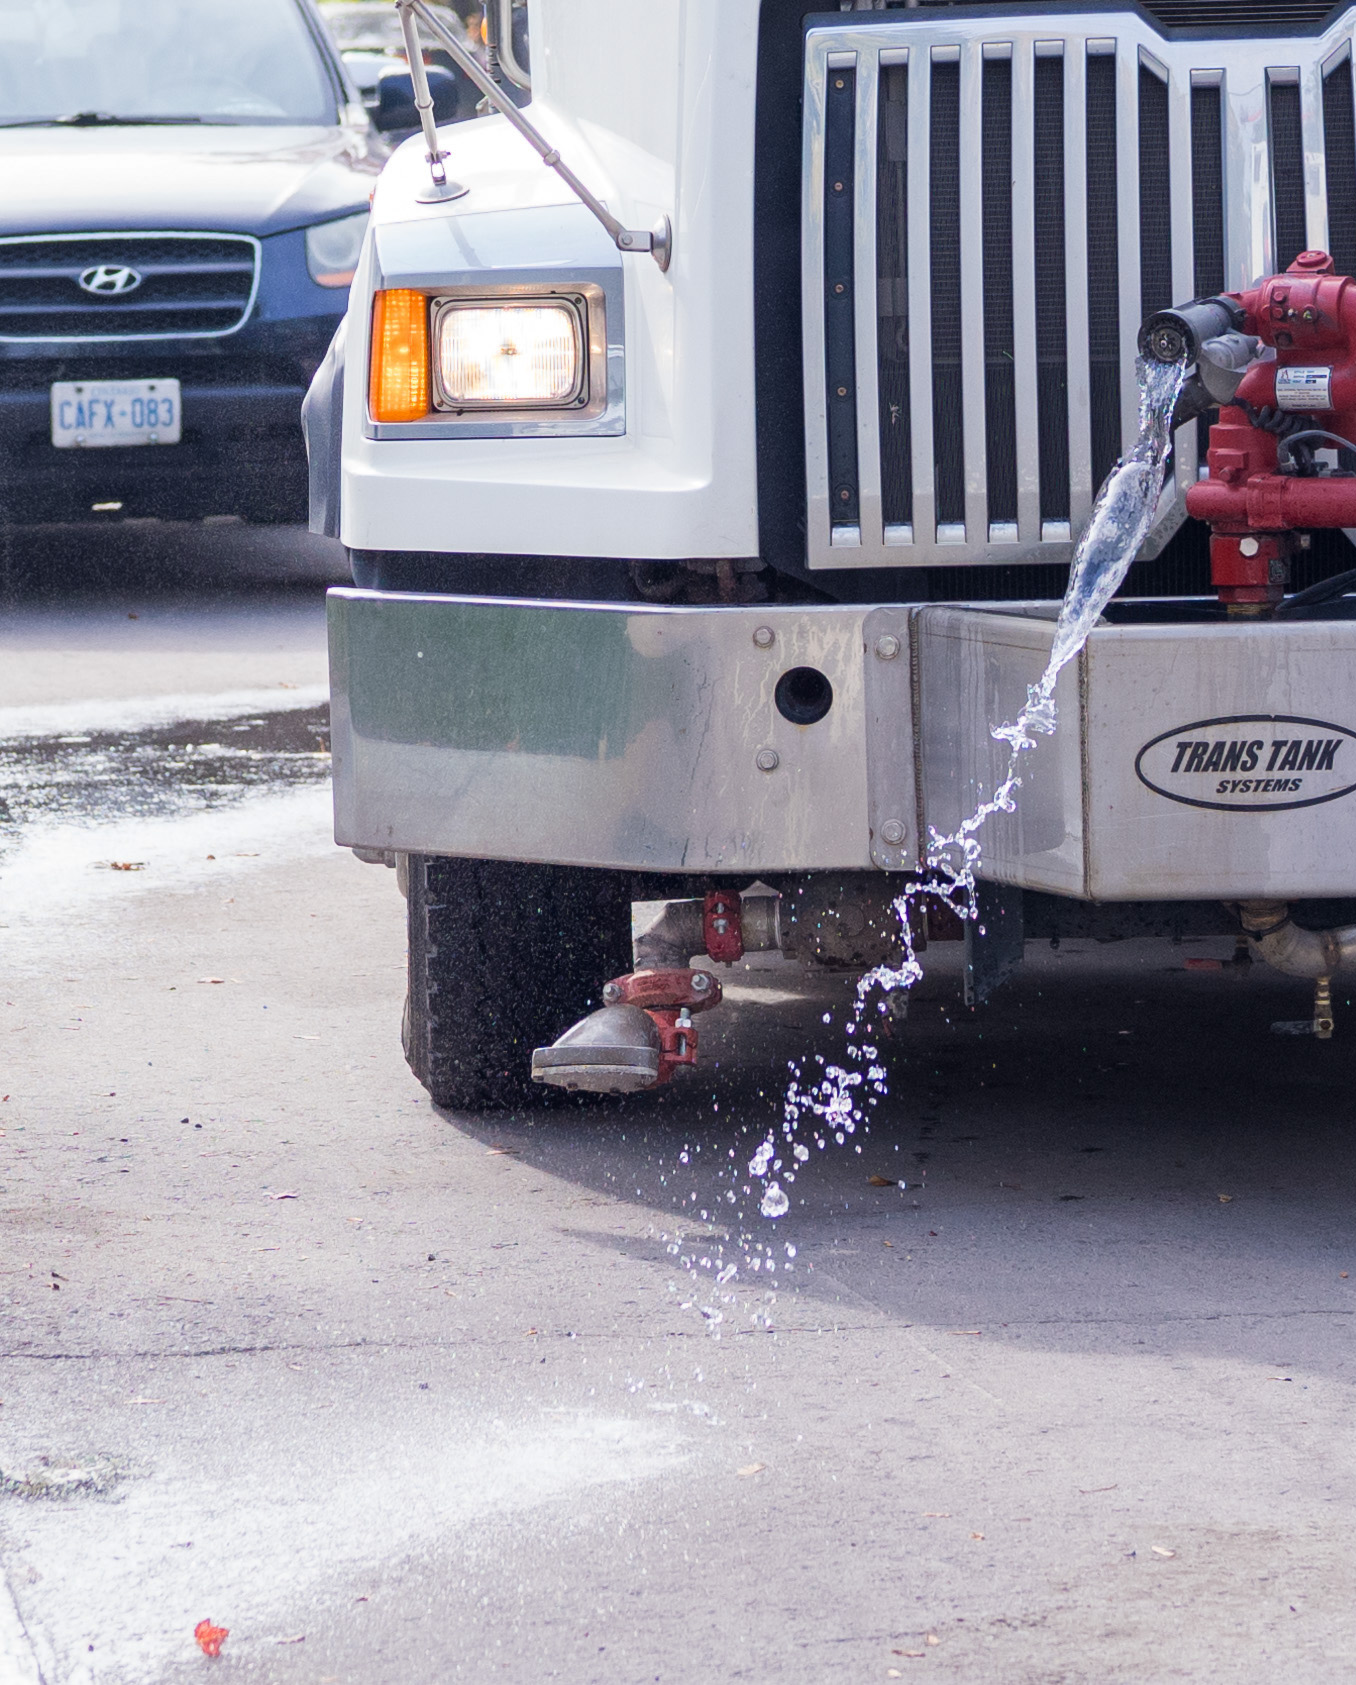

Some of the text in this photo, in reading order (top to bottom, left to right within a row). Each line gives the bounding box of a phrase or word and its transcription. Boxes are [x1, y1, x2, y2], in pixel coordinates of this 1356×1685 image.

[1170, 739, 1344, 773] TRANS TANK
[1216, 778, 1303, 794] SYSTEMS
